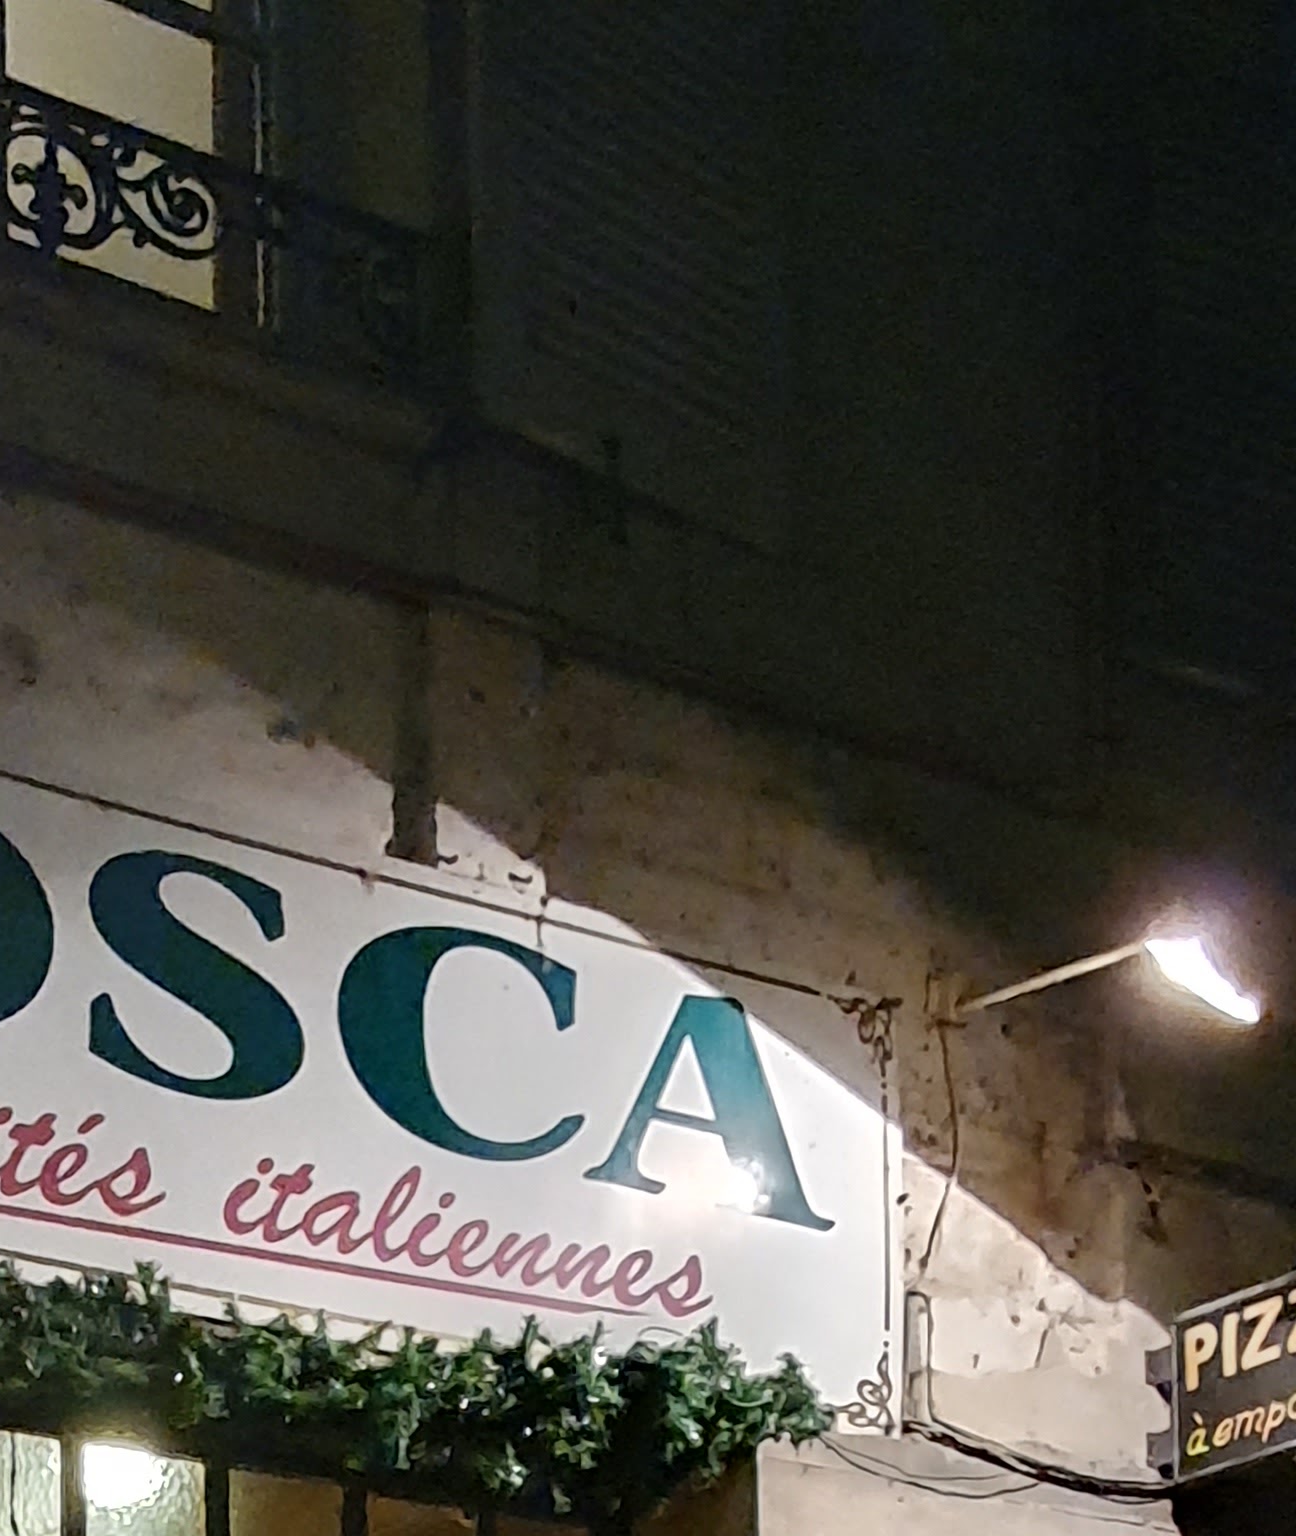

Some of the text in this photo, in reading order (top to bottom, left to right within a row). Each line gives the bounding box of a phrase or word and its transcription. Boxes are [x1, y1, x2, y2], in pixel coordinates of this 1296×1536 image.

[223, 1158, 712, 1317] italiennes
[1184, 1290, 1296, 1392] PIZ
[1186, 1411, 1210, 1456] à
